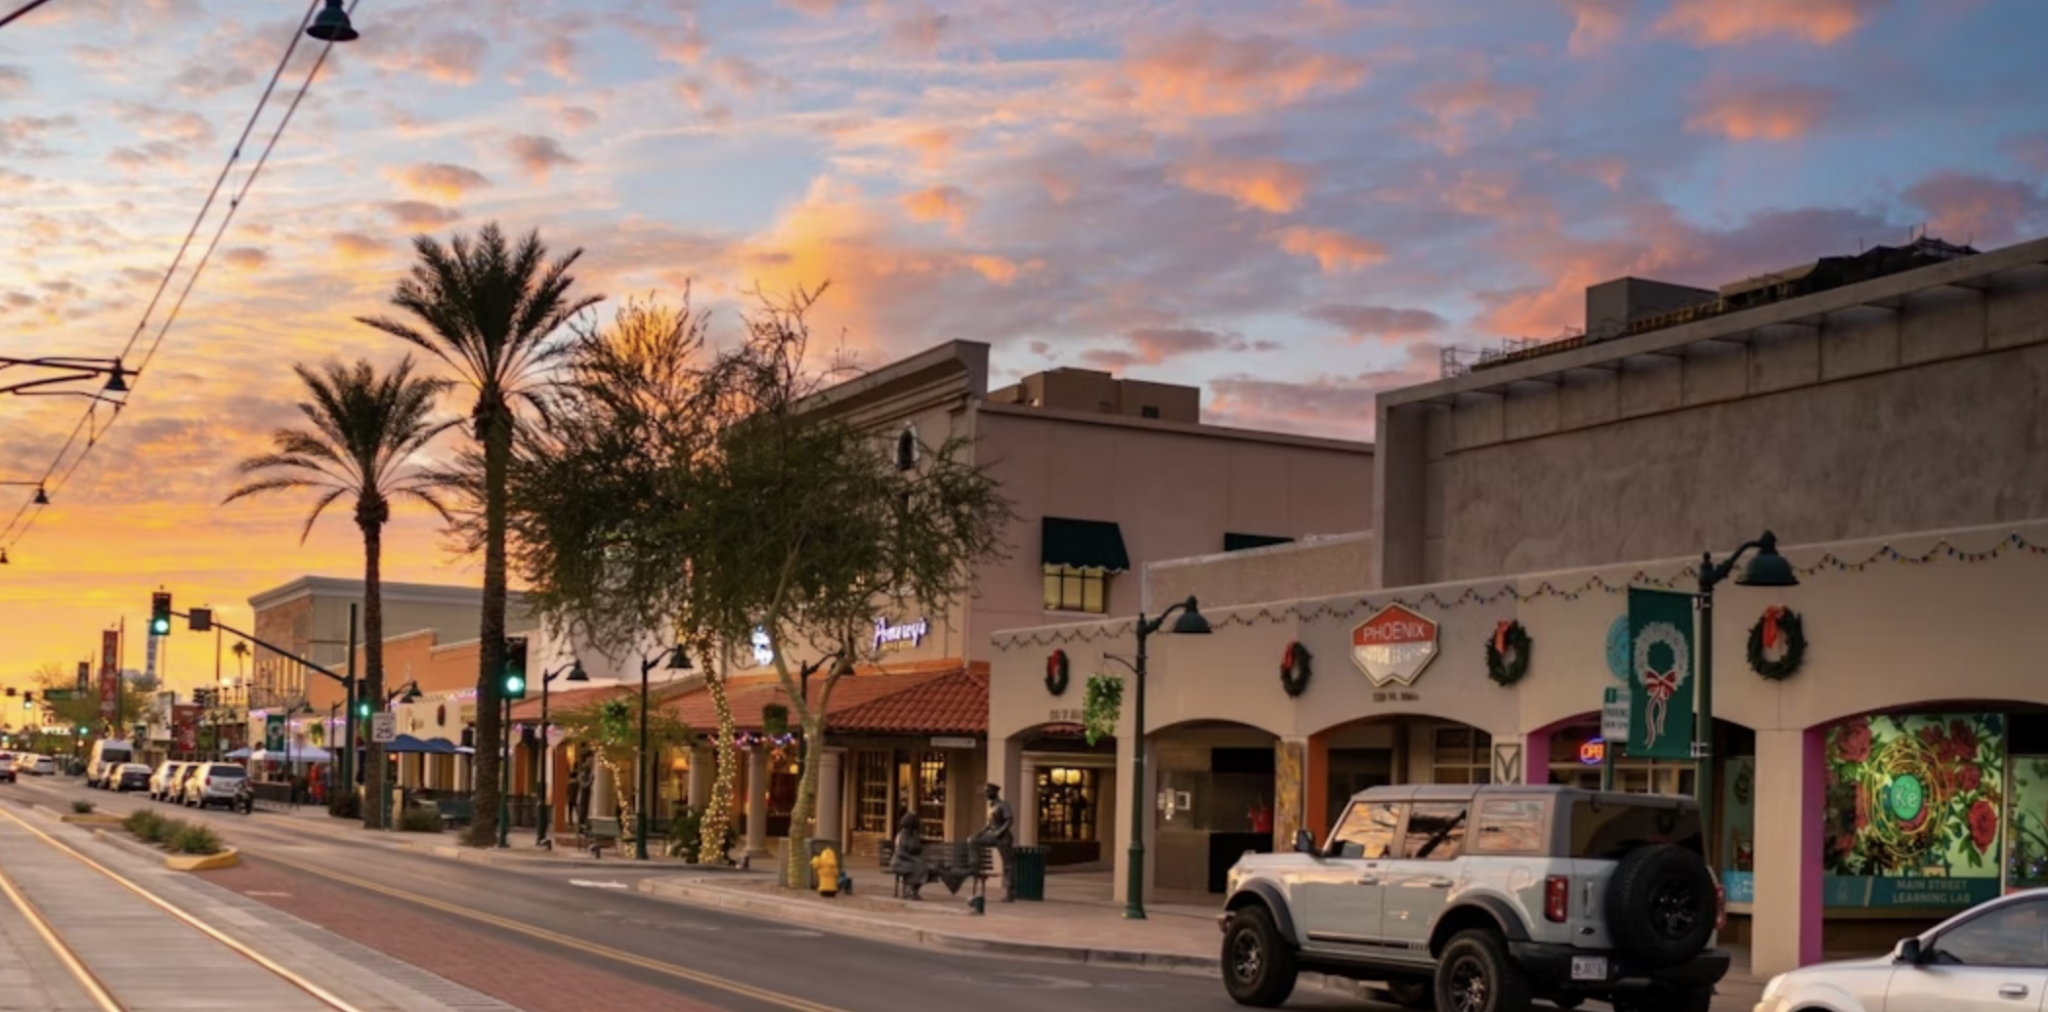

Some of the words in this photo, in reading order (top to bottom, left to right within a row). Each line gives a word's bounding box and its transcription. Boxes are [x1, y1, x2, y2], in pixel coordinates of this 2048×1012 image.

[1363, 621, 1426, 641] PHOENIX
[376, 727, 394, 739] 25
[1894, 786, 1917, 808] Ke
[1896, 879, 1927, 890] MAIN
[1928, 879, 1968, 890] STREET
[1893, 892, 1948, 903] LEARNING
[1950, 892, 1971, 903] LAB
